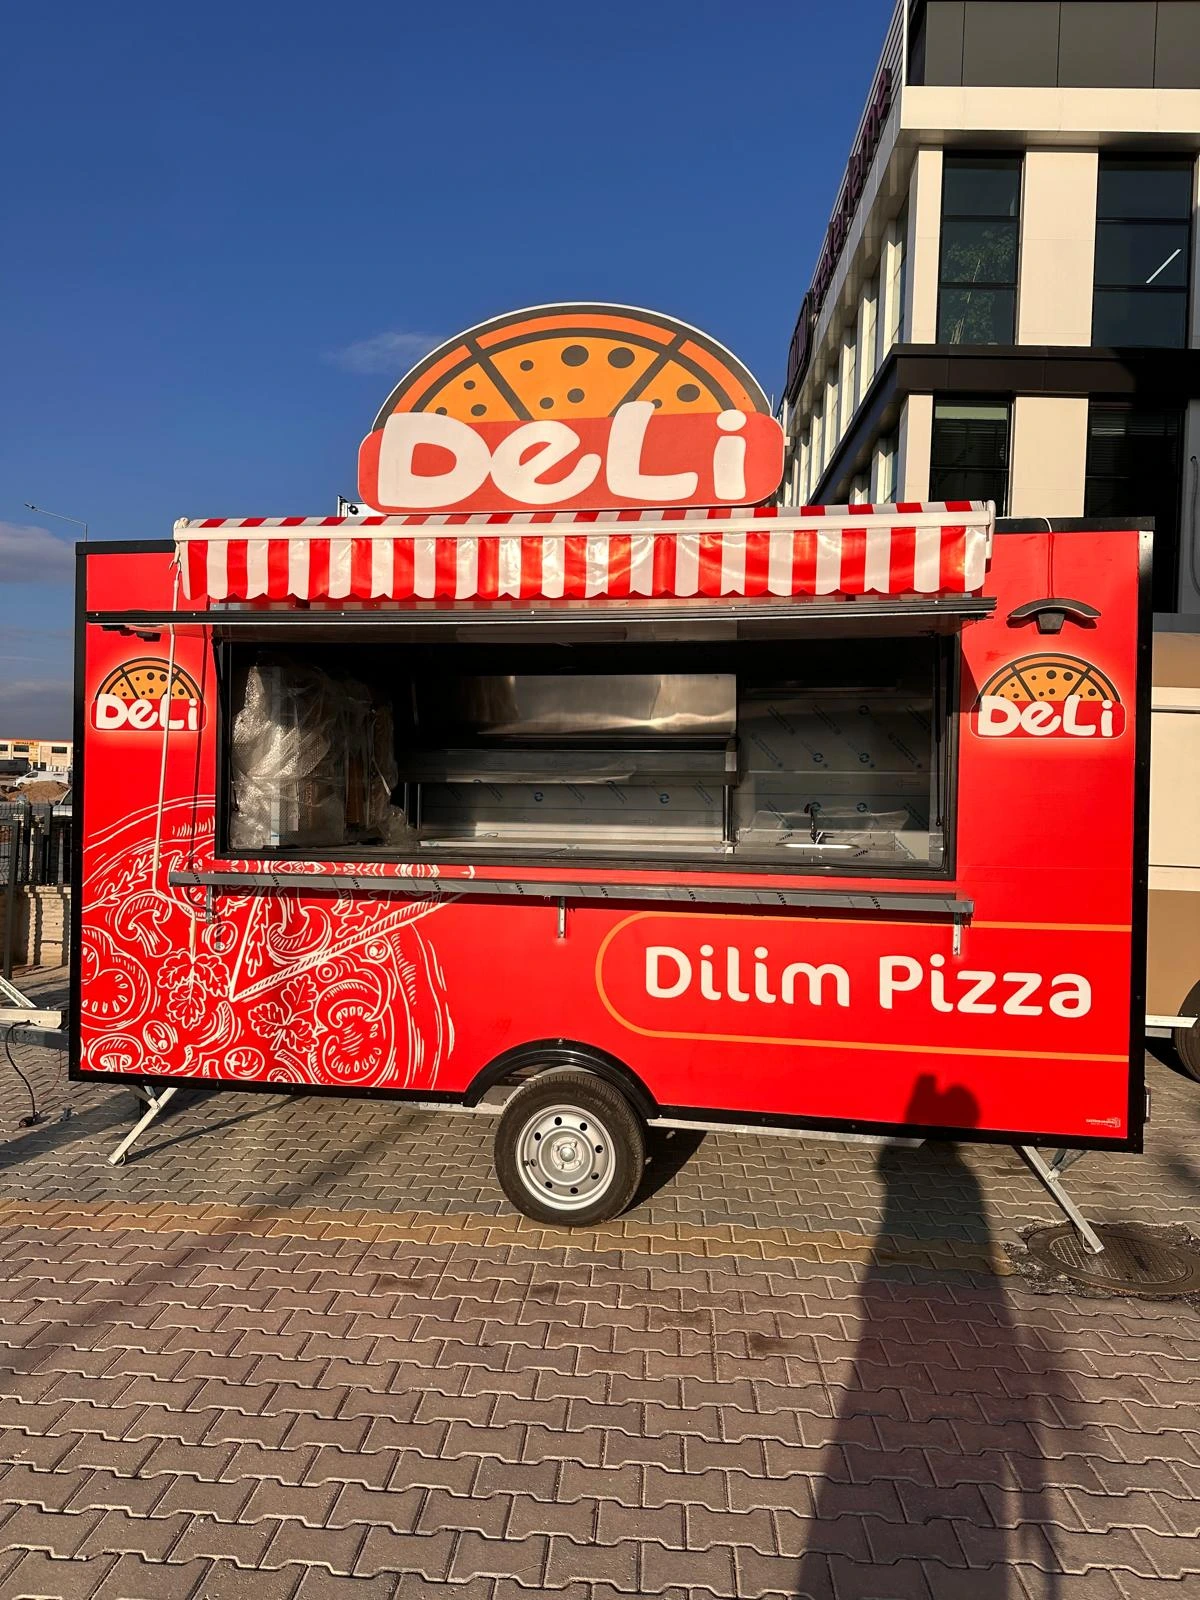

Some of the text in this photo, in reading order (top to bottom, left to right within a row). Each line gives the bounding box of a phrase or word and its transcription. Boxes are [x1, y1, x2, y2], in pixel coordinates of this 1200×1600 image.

[377, 400, 748, 509] DeLi
[96, 693, 198, 731] DeLi
[977, 694, 1113, 737] DeLi
[645, 944, 1092, 1019] Dilim Pizza
